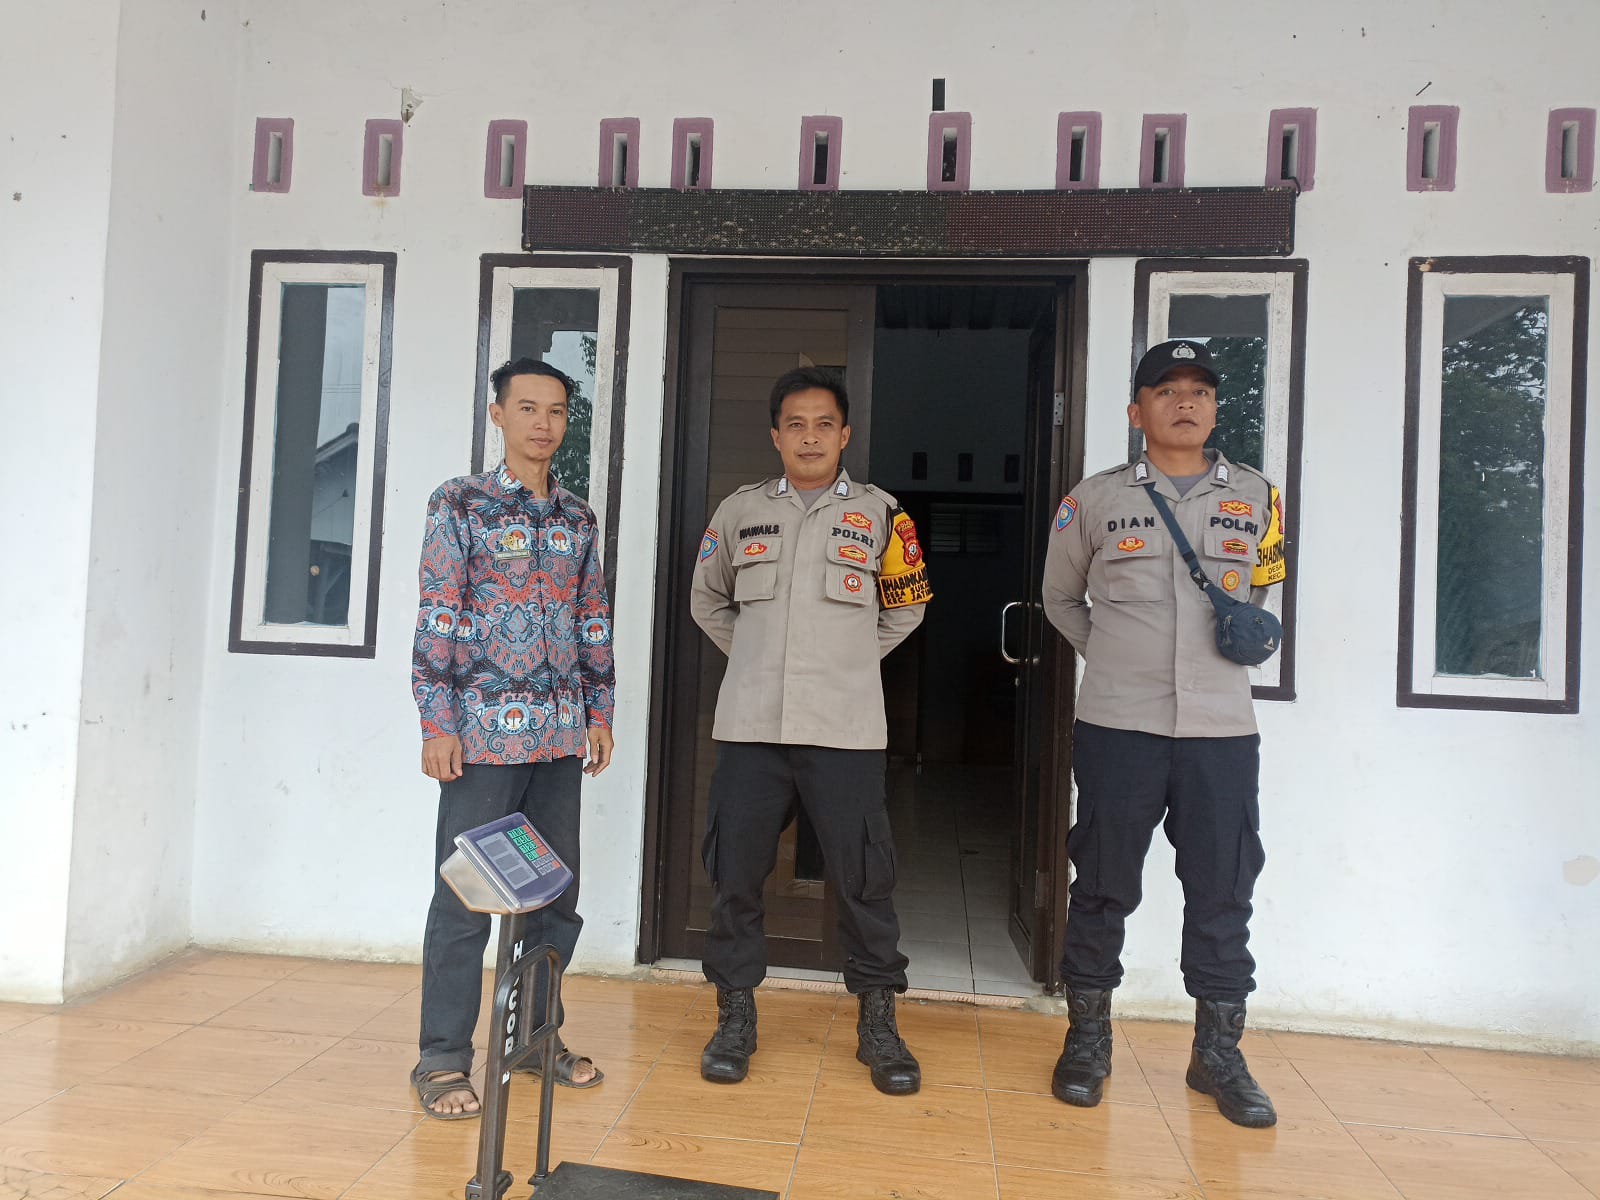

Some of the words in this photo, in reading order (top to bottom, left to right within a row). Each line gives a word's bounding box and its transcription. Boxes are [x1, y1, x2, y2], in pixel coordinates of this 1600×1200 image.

[1108, 516, 1155, 532] DIAN
[1210, 517, 1258, 536] POLRI
[832, 527, 874, 548] POLRI
